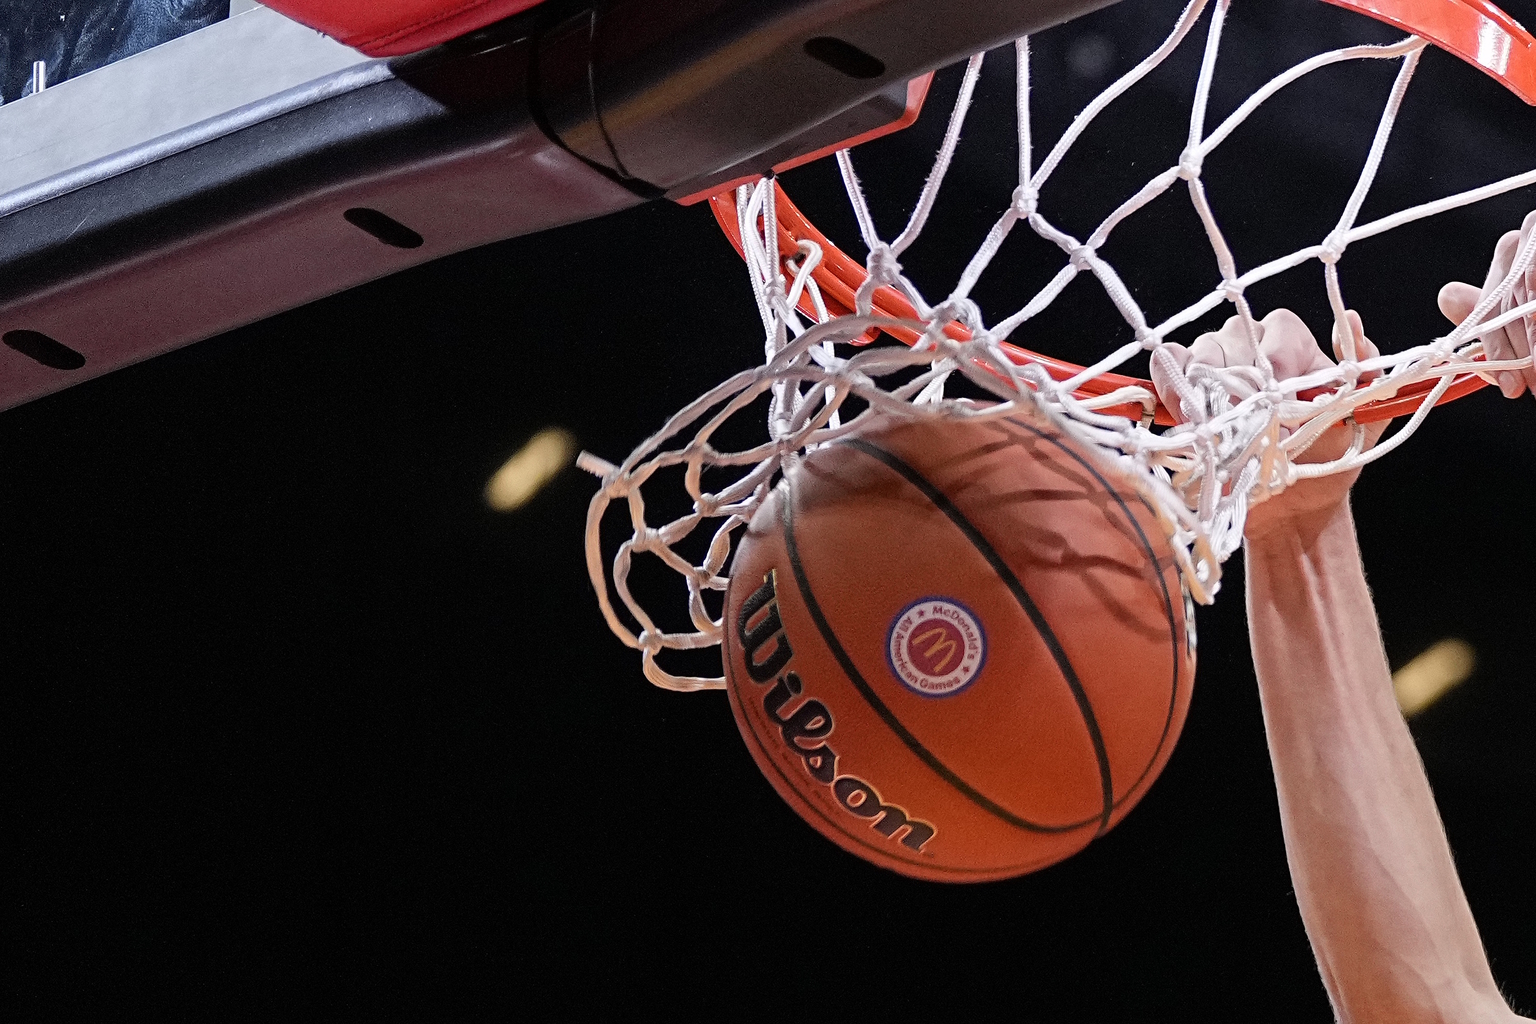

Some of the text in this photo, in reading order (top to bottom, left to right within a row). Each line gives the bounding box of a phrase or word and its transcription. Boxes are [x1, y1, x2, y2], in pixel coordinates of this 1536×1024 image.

[932, 605, 978, 660] McDonald's
[919, 676, 961, 690] Games
[738, 568, 938, 854] Wilson
